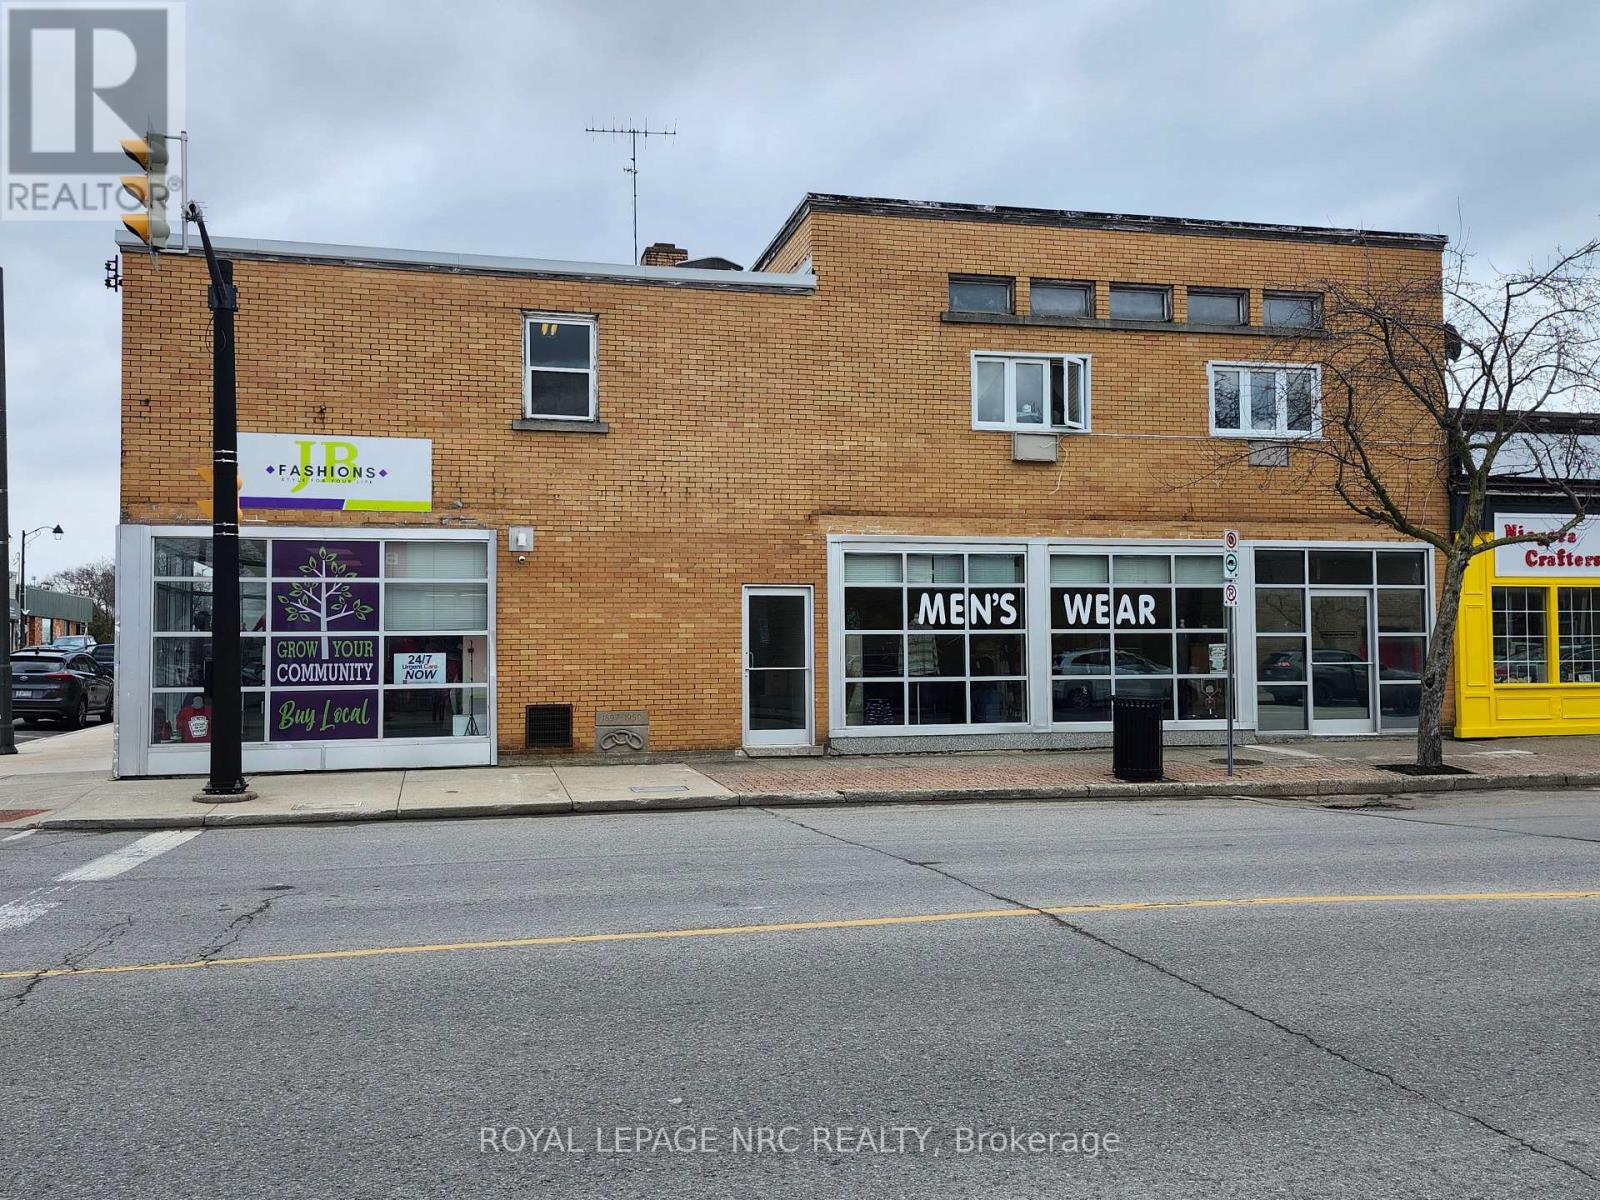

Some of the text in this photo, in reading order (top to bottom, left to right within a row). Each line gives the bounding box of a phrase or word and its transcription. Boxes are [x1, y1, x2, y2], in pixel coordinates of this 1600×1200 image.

[279, 465, 375, 478] FASHIONS
[290, 440, 359, 493] JB
[1063, 594, 1156, 625] WEAR
[277, 640, 374, 658] GROW YOUR
[407, 655, 433, 664] 24/7
[276, 663, 374, 682] COMMUNITY
[405, 670, 438, 680] NOW
[279, 698, 370, 731] Buy Local
